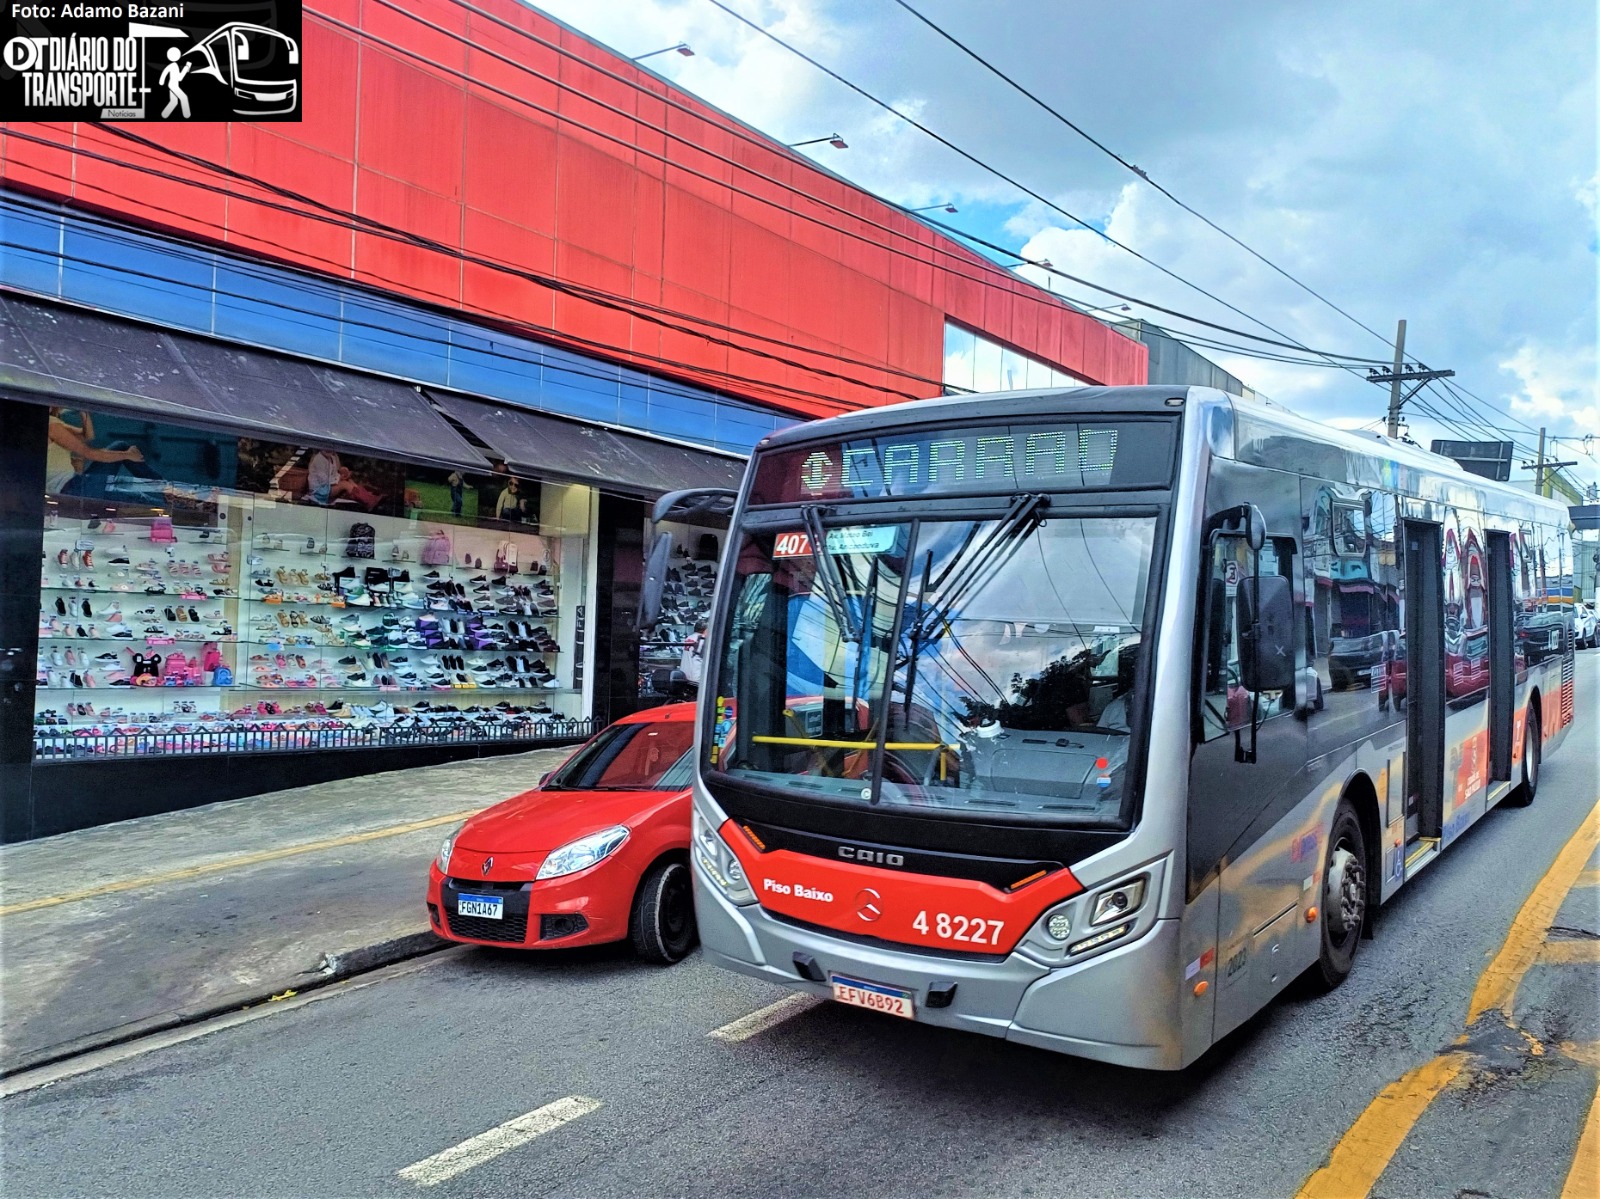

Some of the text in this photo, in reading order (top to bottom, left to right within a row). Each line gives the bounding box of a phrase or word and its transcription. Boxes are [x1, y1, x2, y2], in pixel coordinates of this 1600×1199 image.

[837, 846, 904, 867] CAIO
[763, 878, 834, 903] Piso Baixo
[461, 901, 498, 917] FGN1A67
[913, 910, 1005, 946] 4 8227
[838, 986, 905, 1015] EFV6B92
